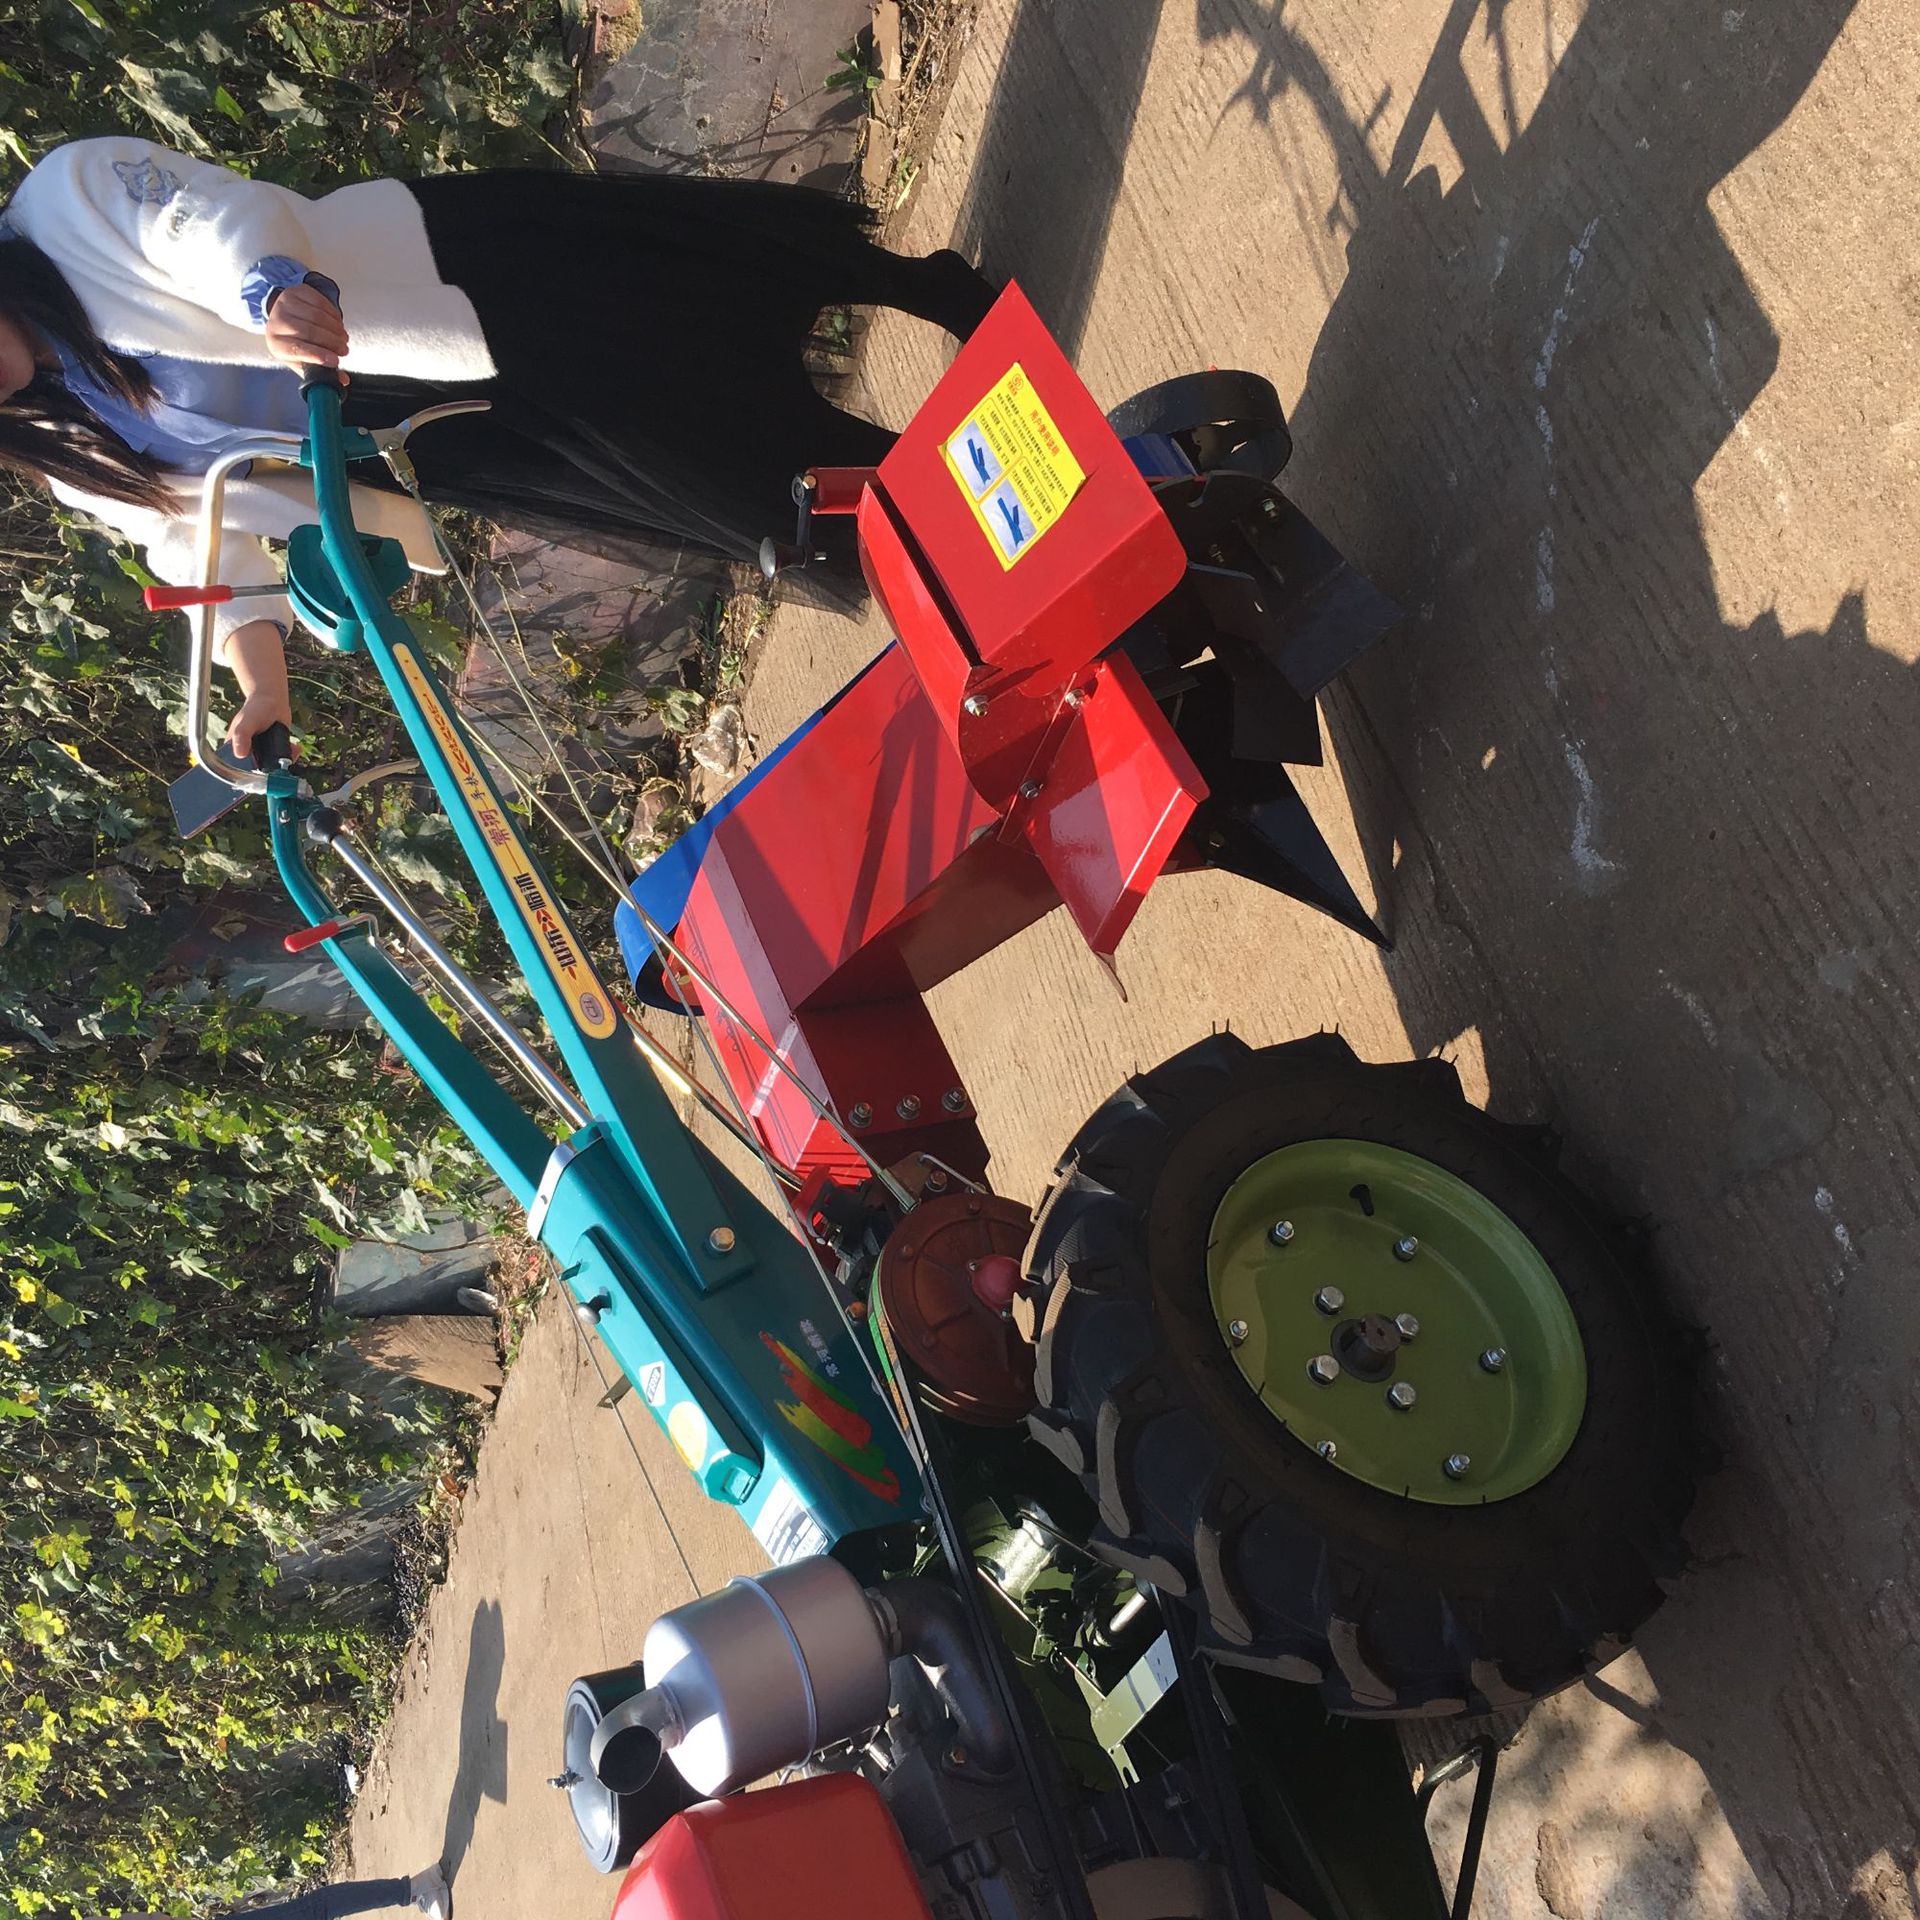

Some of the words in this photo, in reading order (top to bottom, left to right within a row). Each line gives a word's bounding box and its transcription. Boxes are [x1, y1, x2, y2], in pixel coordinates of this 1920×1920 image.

[463, 771, 486, 801] 手扶
[477, 808, 512, 847] 常河
[514, 872, 547, 912] 临沭
[543, 928, 577, 971] 山东
